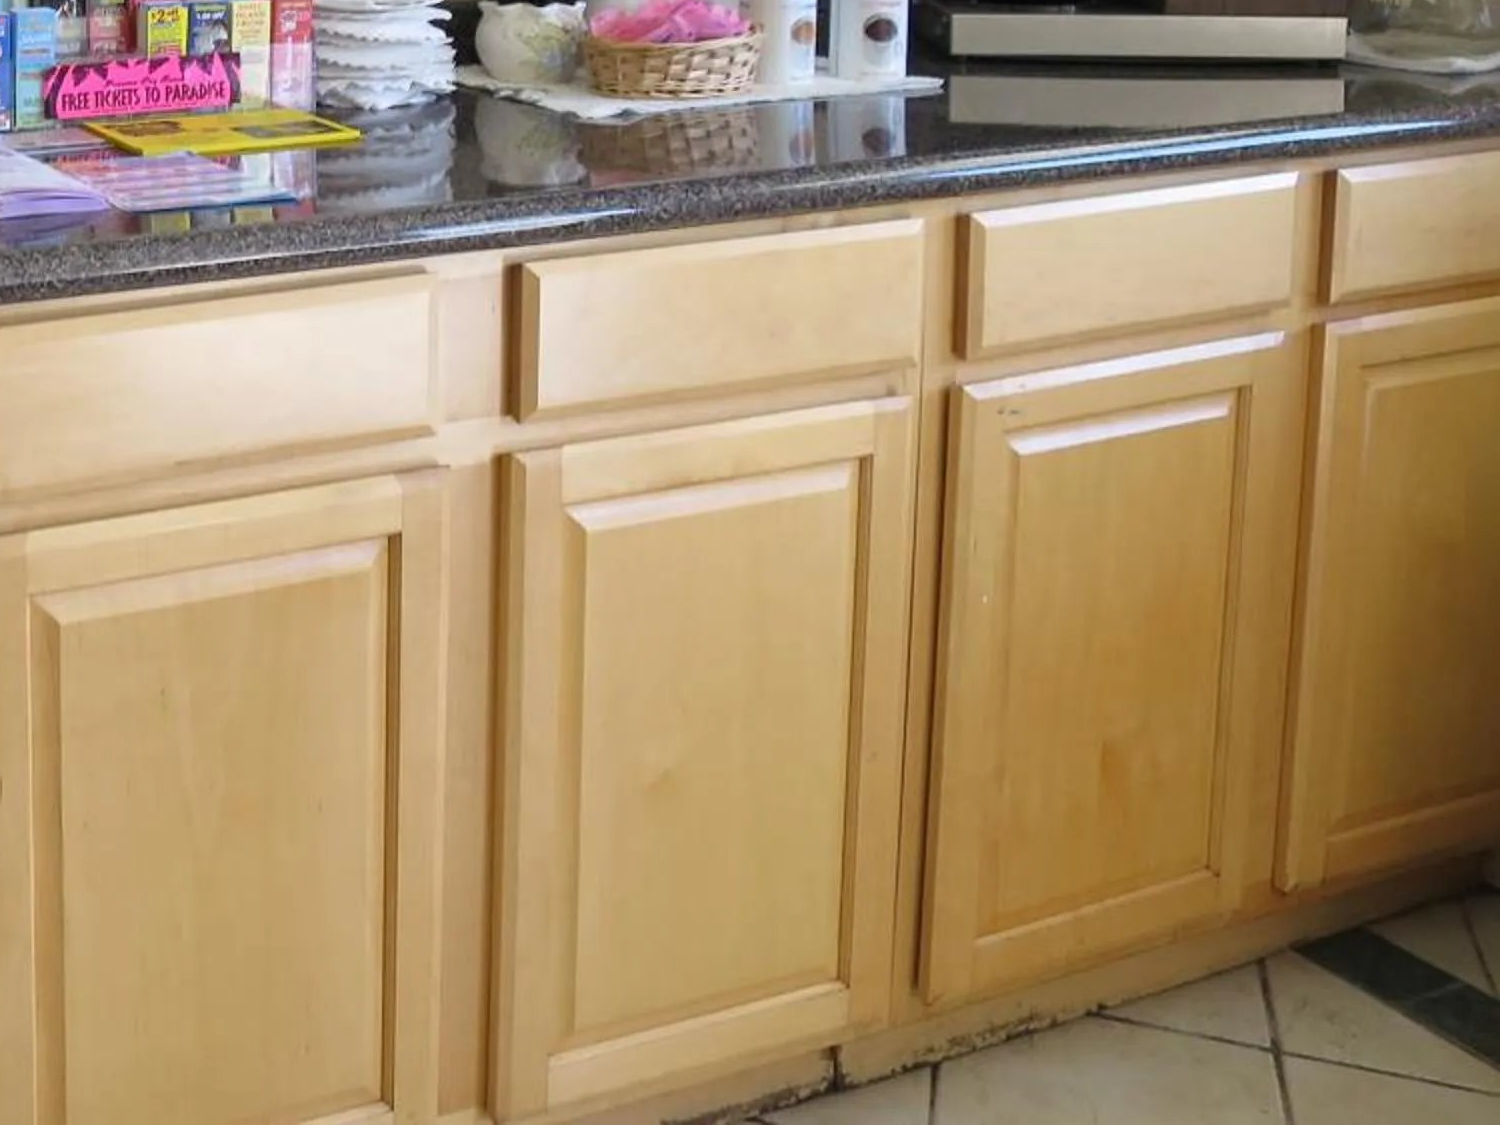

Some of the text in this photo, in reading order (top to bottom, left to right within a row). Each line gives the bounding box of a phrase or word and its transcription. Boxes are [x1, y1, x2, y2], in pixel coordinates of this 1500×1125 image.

[61, 80, 226, 112] FREE TICKETS TO PARADISE
